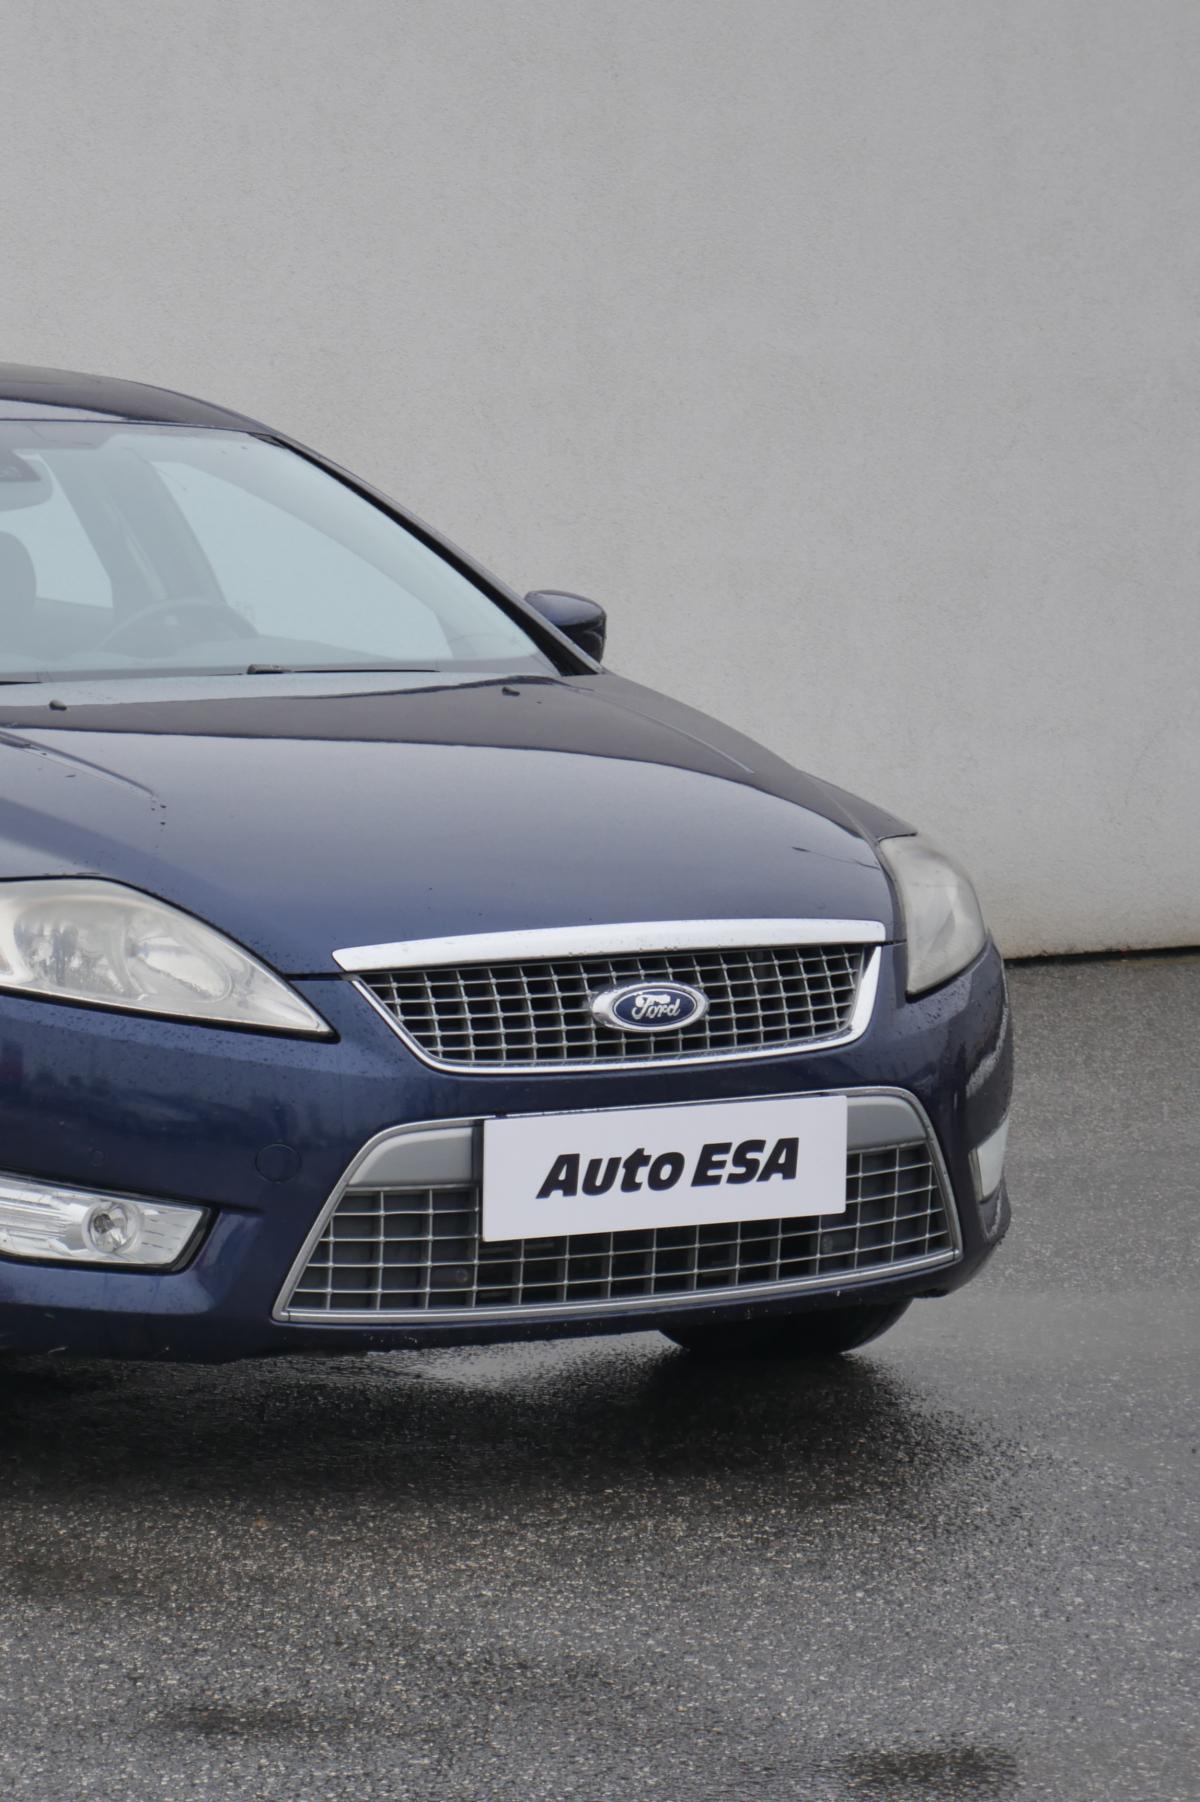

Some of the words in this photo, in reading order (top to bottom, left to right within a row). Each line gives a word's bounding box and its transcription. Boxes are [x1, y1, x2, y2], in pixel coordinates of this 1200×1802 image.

[631, 993, 681, 1020] Ford
[535, 1147, 685, 1200] Auto
[690, 1137, 800, 1188] ESA
